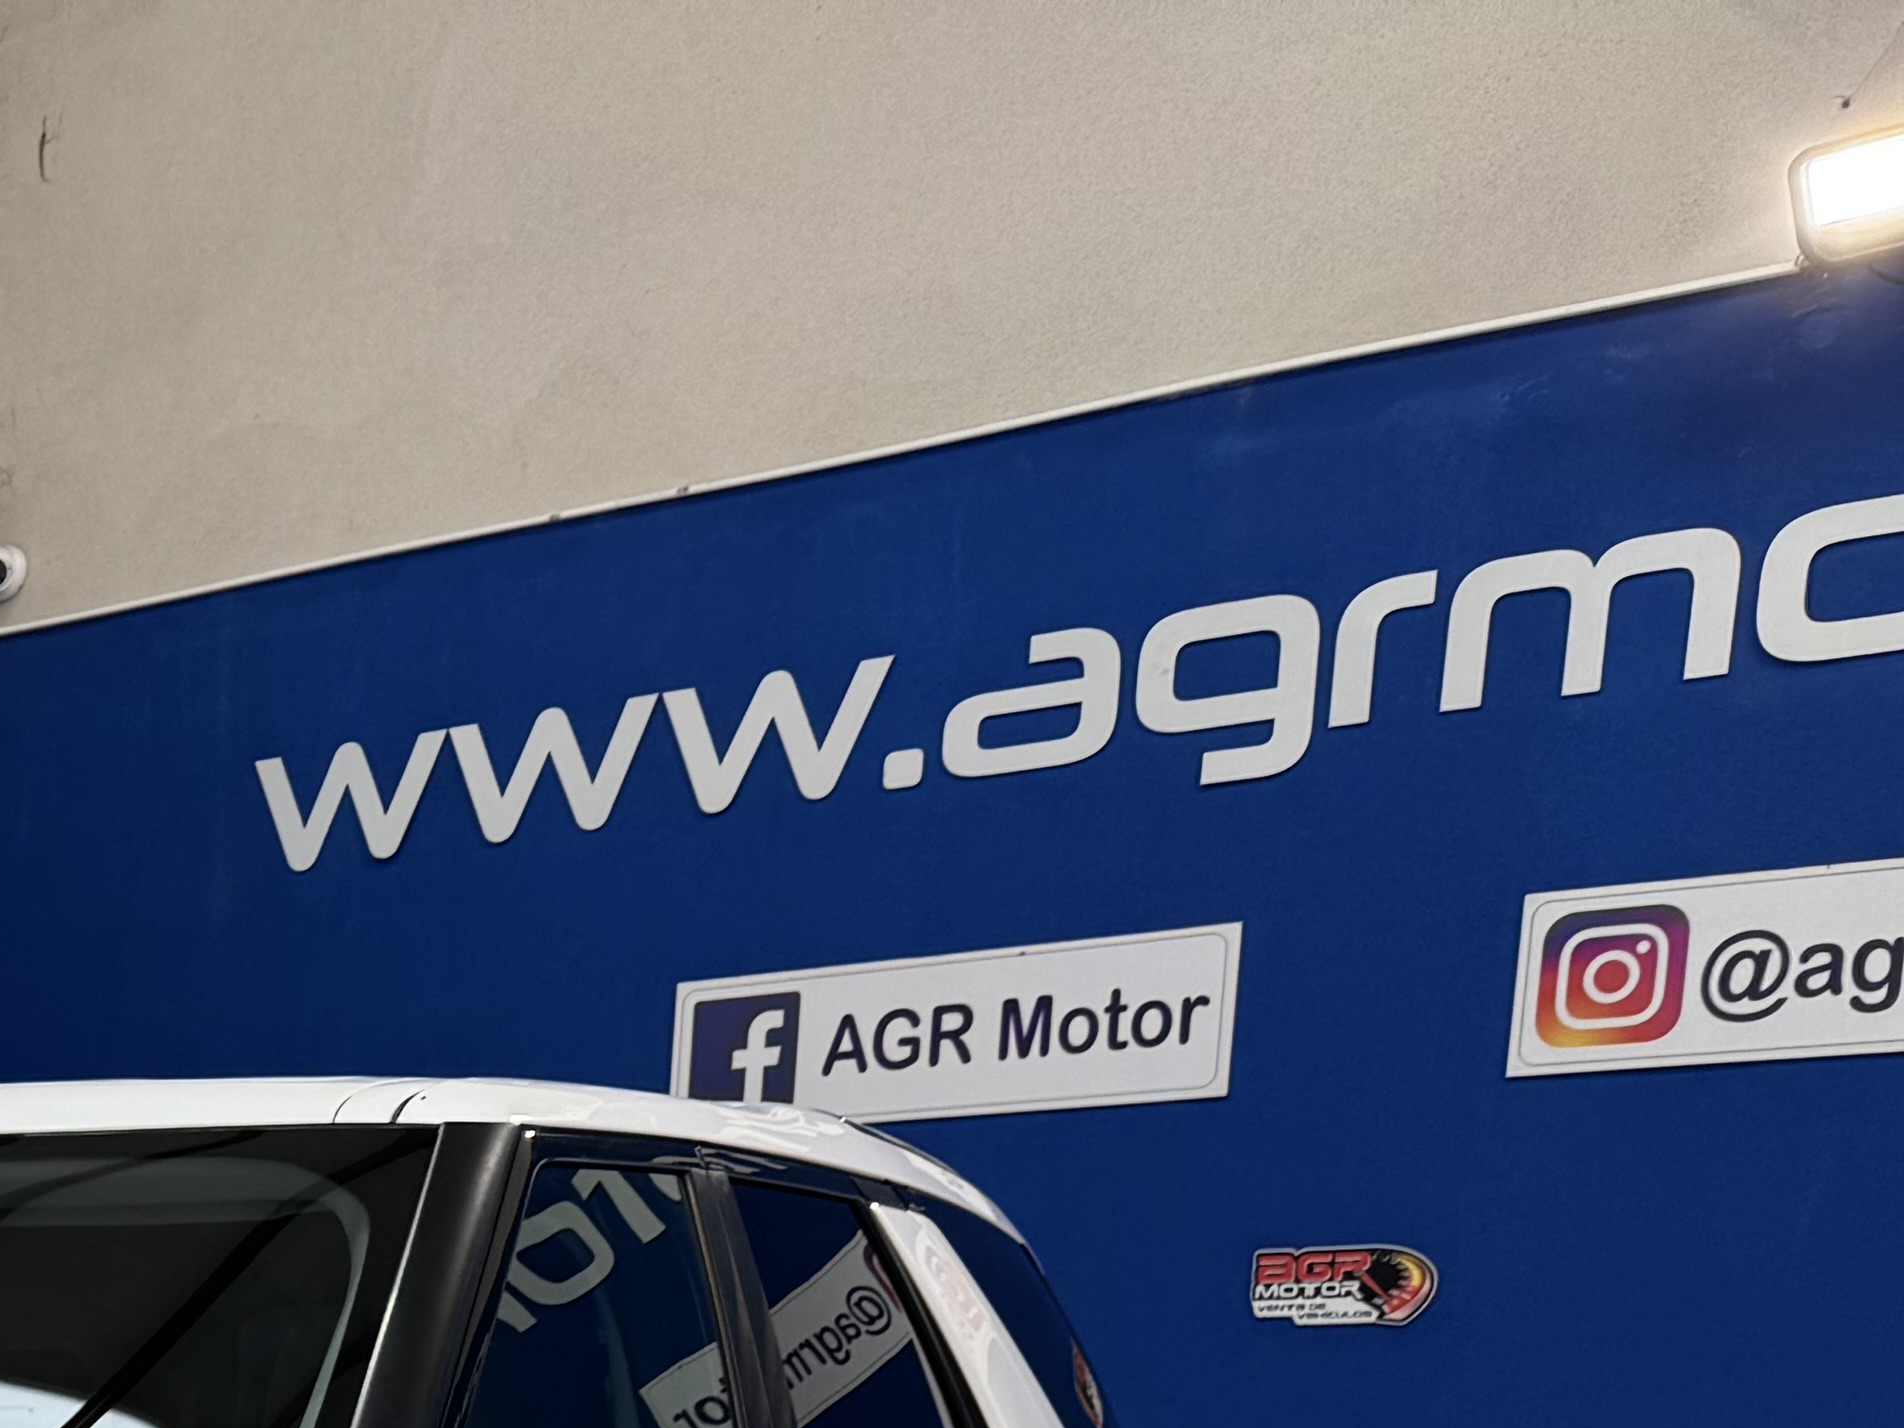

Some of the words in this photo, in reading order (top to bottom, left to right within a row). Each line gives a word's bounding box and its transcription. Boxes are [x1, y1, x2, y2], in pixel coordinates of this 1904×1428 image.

[254, 493, 1904, 871] www.agrmo
[821, 1003, 974, 1077] AGR
[998, 987, 1211, 1061] Motor
[1254, 1280, 1364, 1300] MOTOR
[1257, 1251, 1371, 1284] AGR
